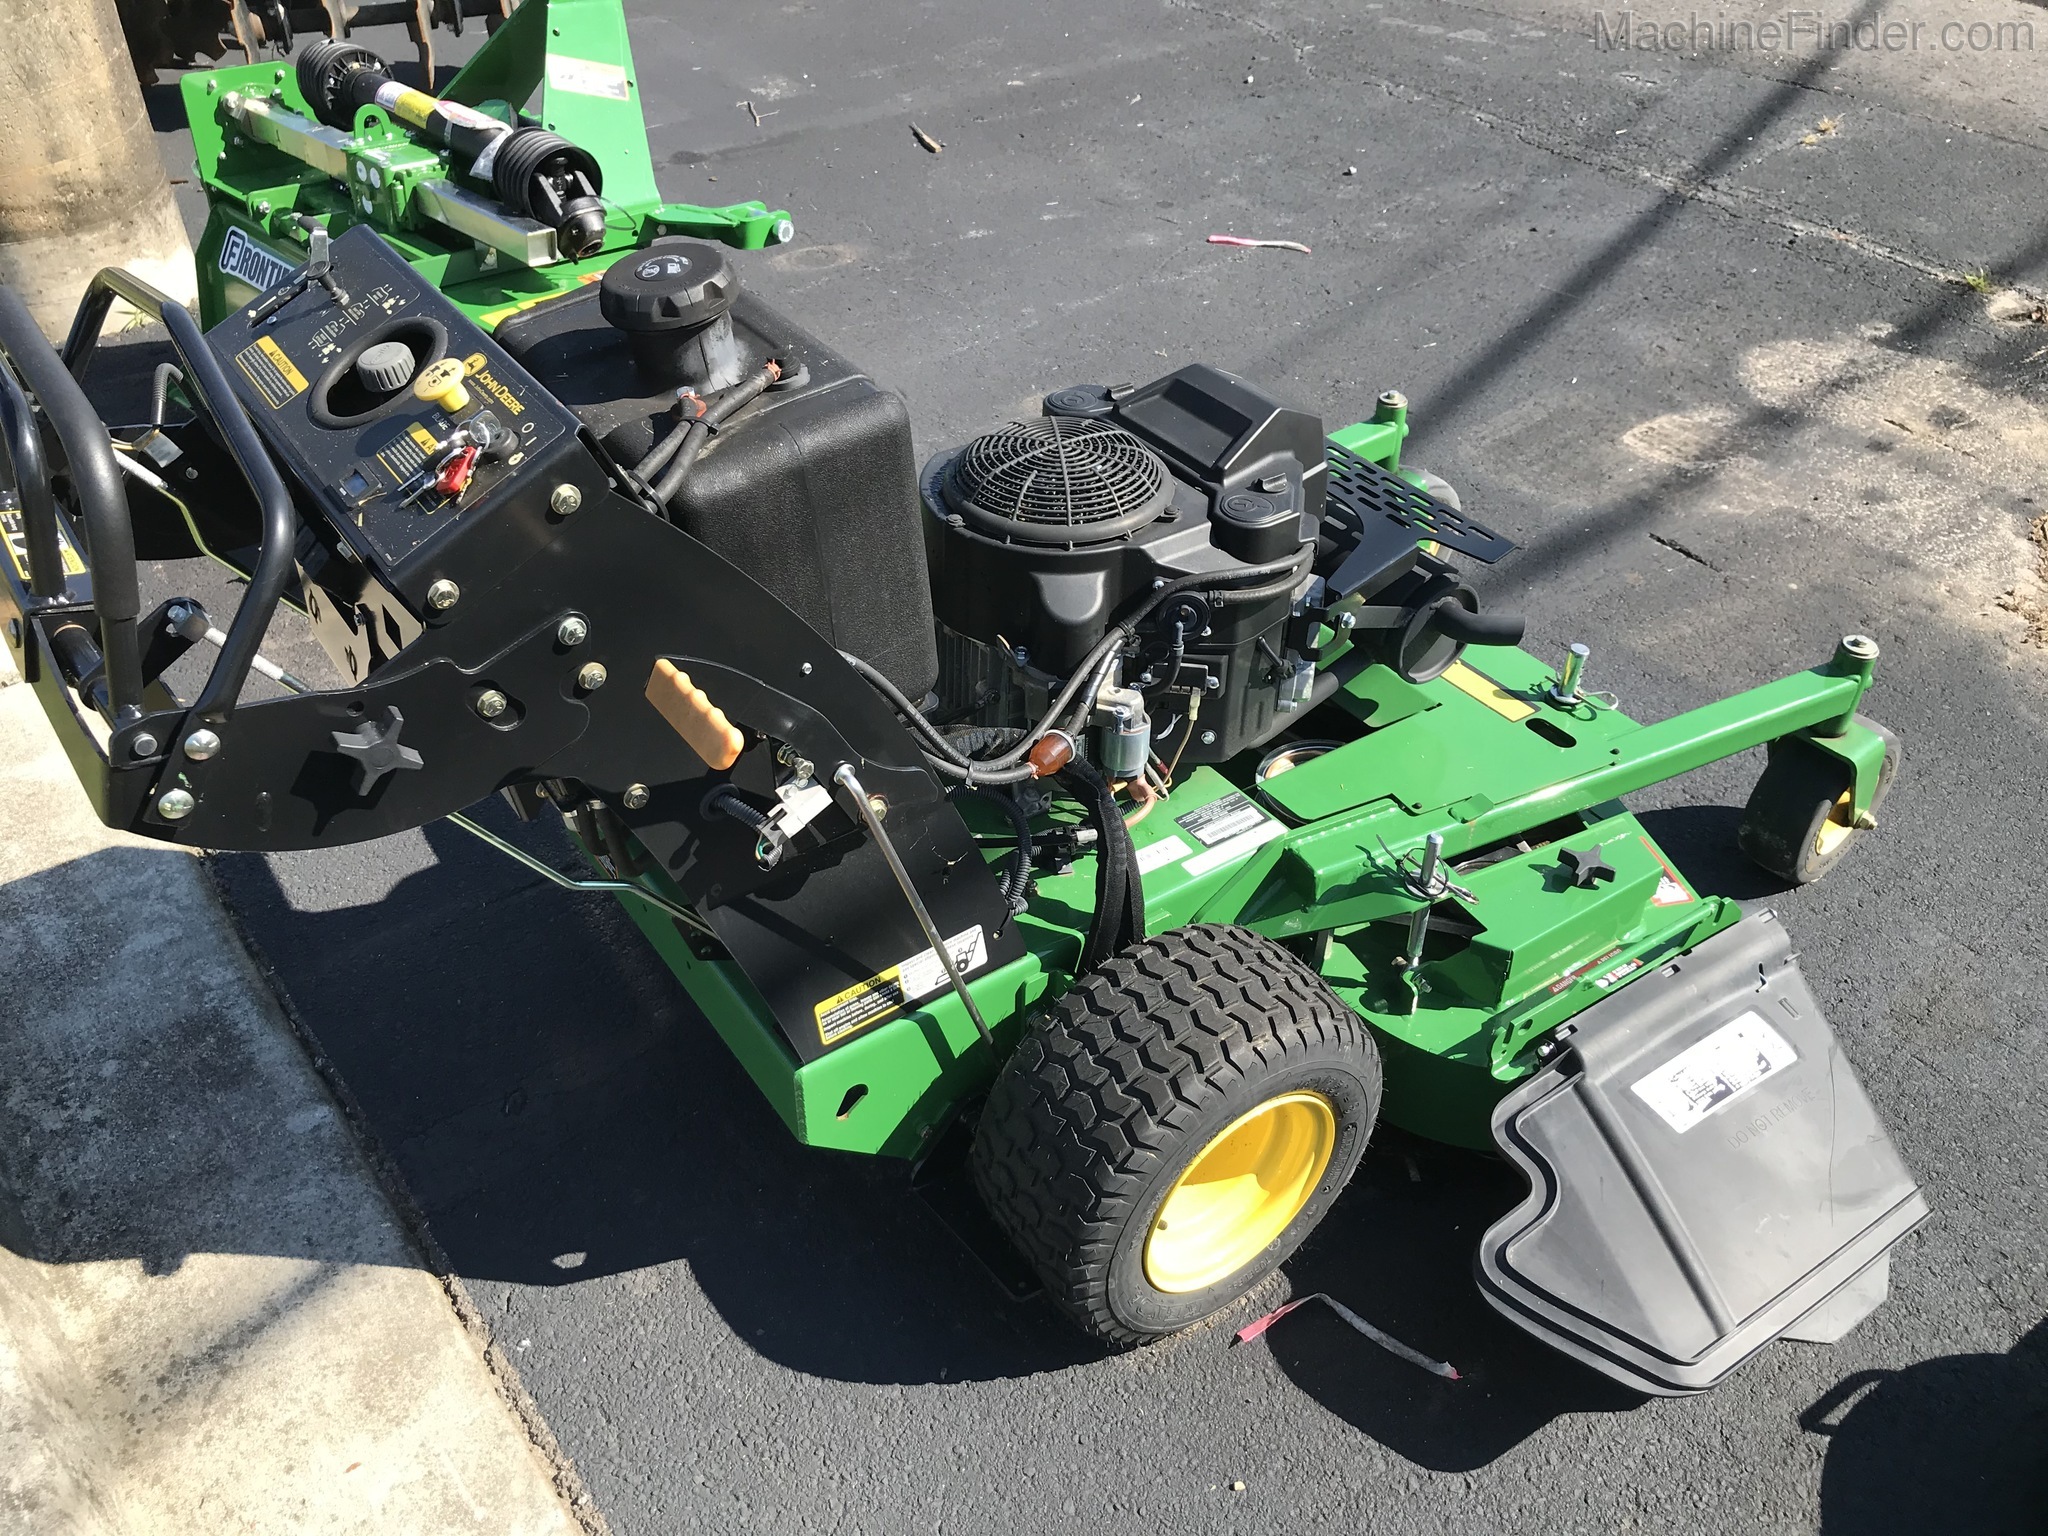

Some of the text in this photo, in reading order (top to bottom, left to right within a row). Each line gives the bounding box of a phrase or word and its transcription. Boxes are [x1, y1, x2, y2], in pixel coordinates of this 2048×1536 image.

[273, 353, 294, 375] CAUTION
[475, 370, 525, 416] JOHN DEERE
[432, 412, 450, 431] BLADE
[845, 976, 881, 998] CAUTION
[1727, 1087, 1816, 1150] DO NOT REMOVE
